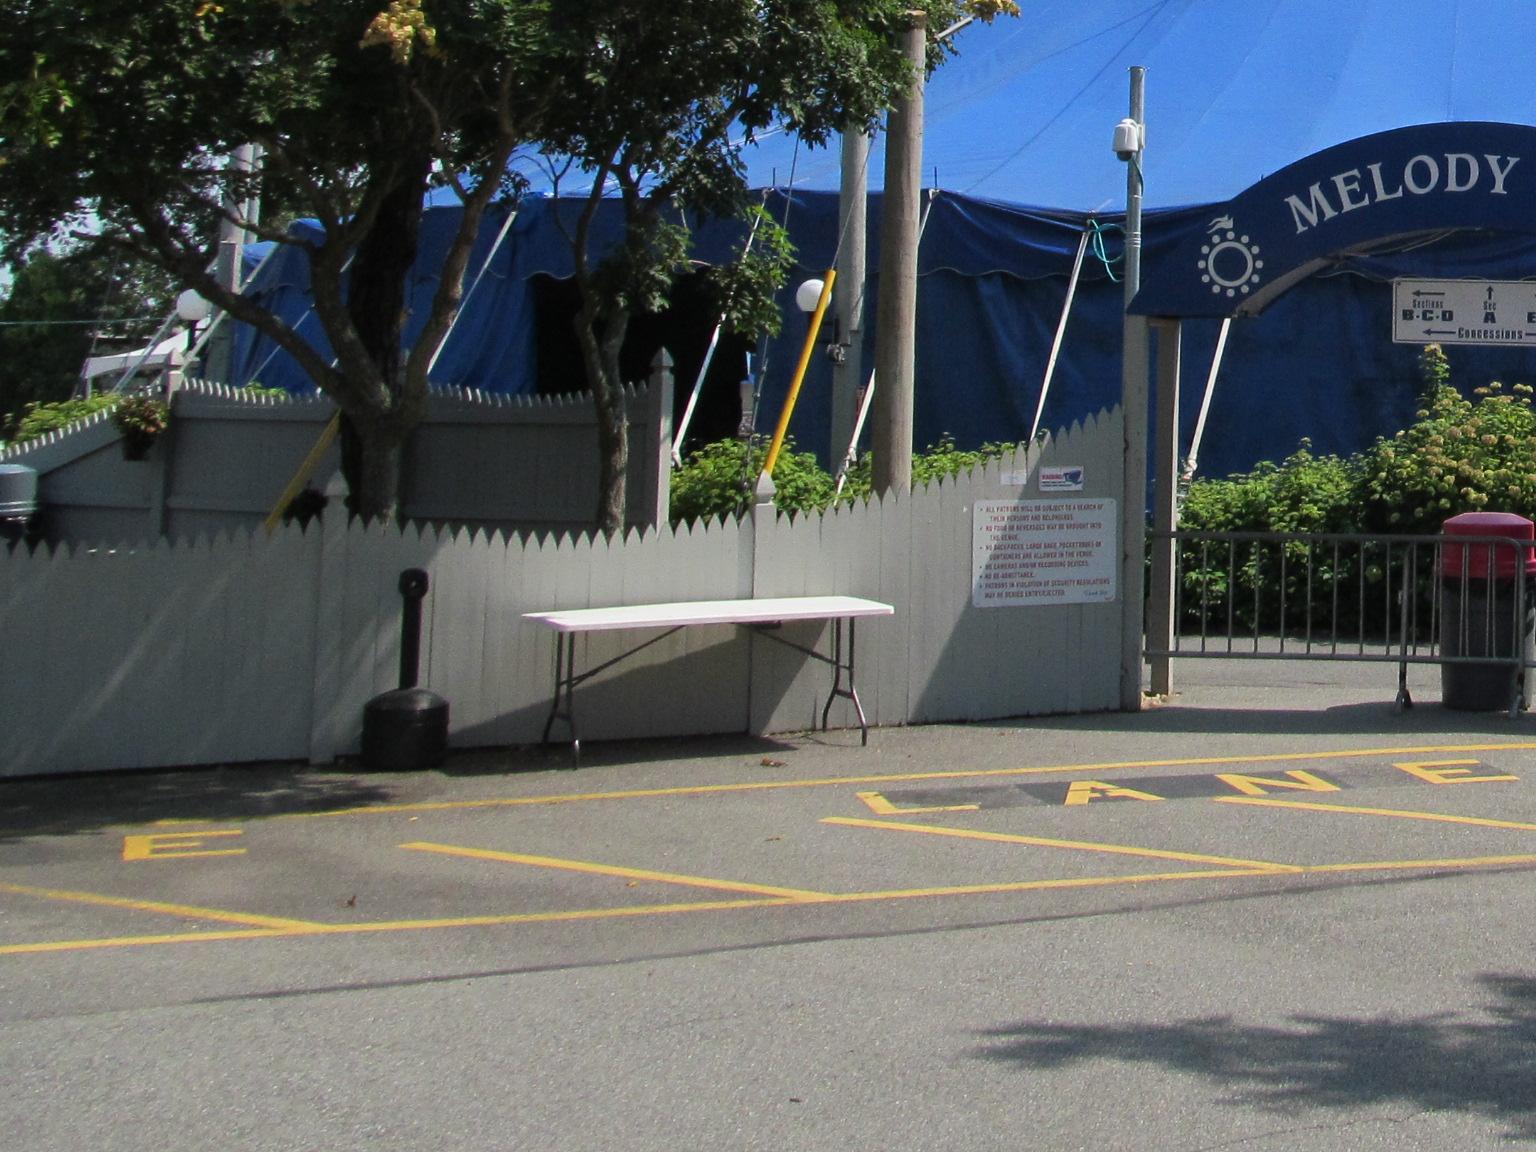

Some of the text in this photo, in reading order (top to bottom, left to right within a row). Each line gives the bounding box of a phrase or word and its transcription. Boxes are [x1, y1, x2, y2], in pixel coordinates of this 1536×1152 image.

[1284, 152, 1521, 235] MELODY
[1412, 299, 1444, 309] Sections
[1483, 301, 1497, 311] Sec
[1483, 311, 1497, 324] A
[1457, 326, 1524, 340] Concessions
[856, 759, 1519, 815] LANE
